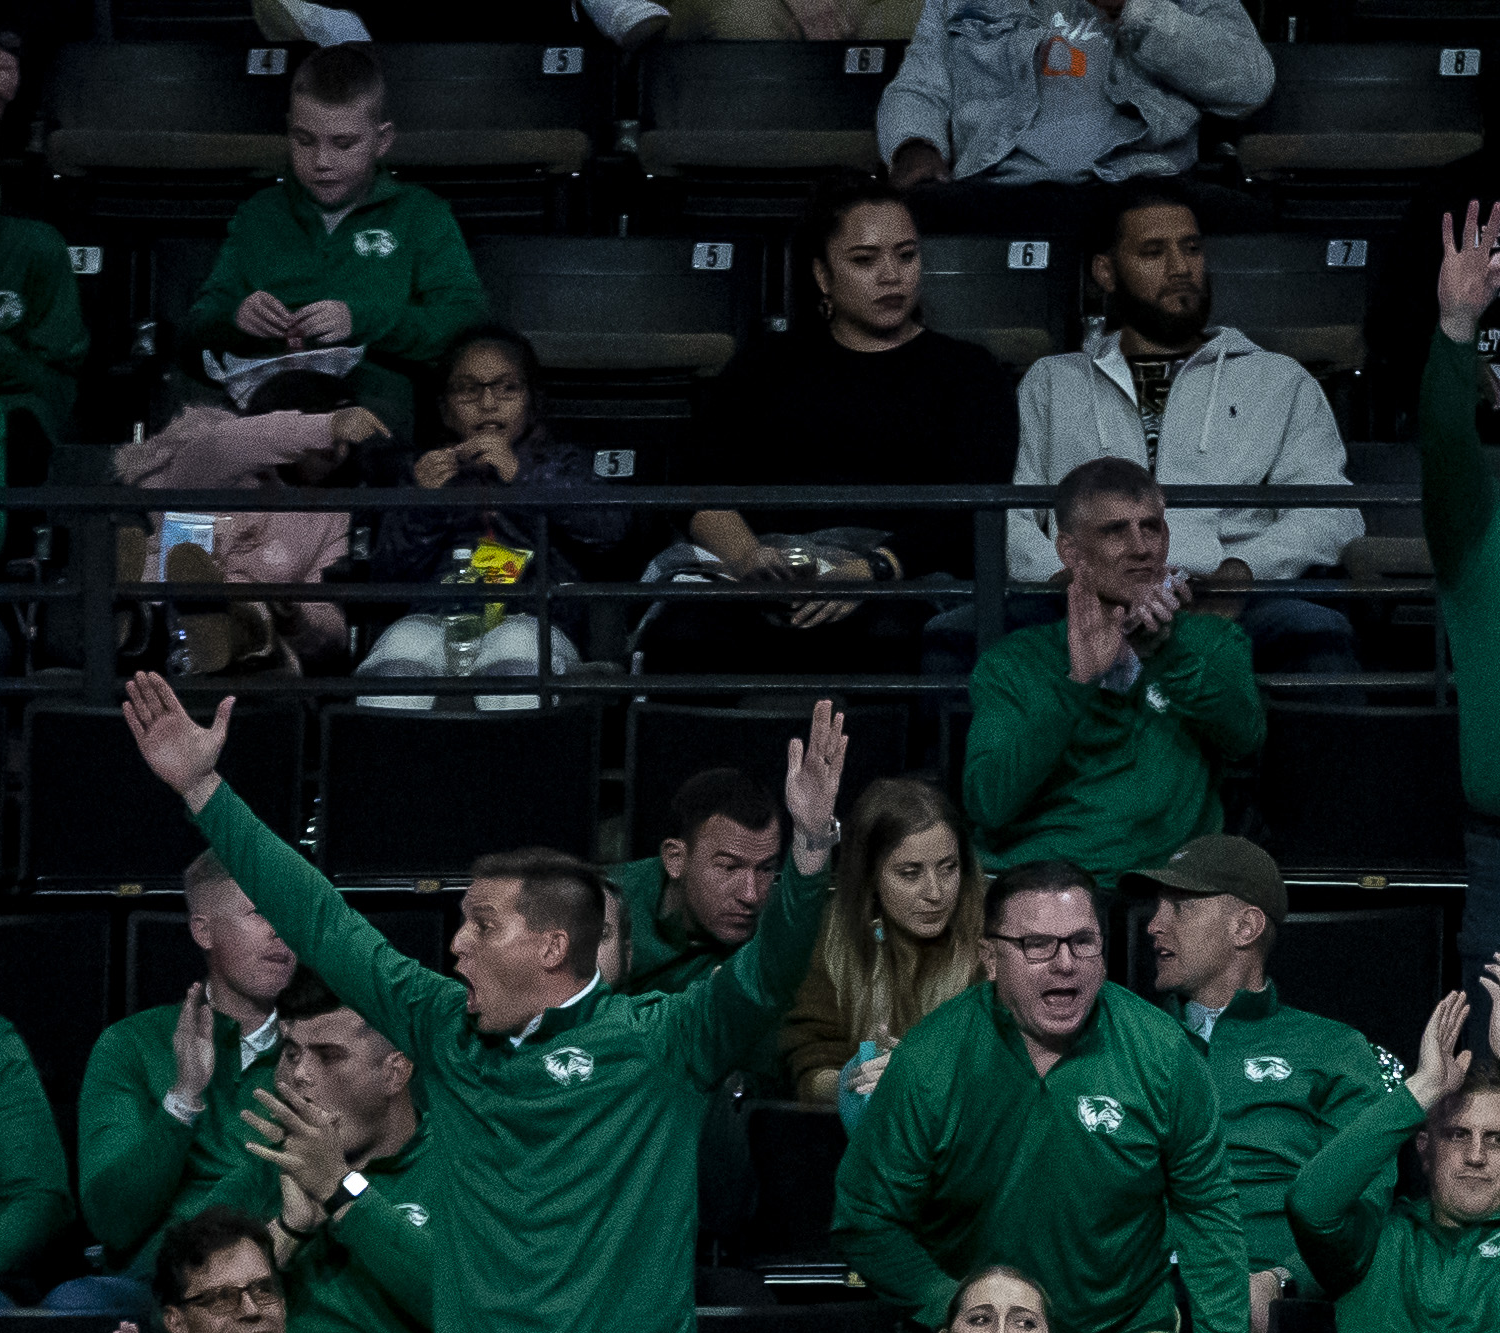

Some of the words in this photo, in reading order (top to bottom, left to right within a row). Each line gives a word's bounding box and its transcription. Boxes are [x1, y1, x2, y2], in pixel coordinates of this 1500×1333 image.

[556, 49, 569, 71] 5
[856, 48, 869, 71] 6
[1454, 51, 1465, 74] 8
[704, 245, 718, 268] 5
[1022, 243, 1034, 267] 6
[1342, 241, 1353, 264] 7
[609, 451, 620, 476] 5
